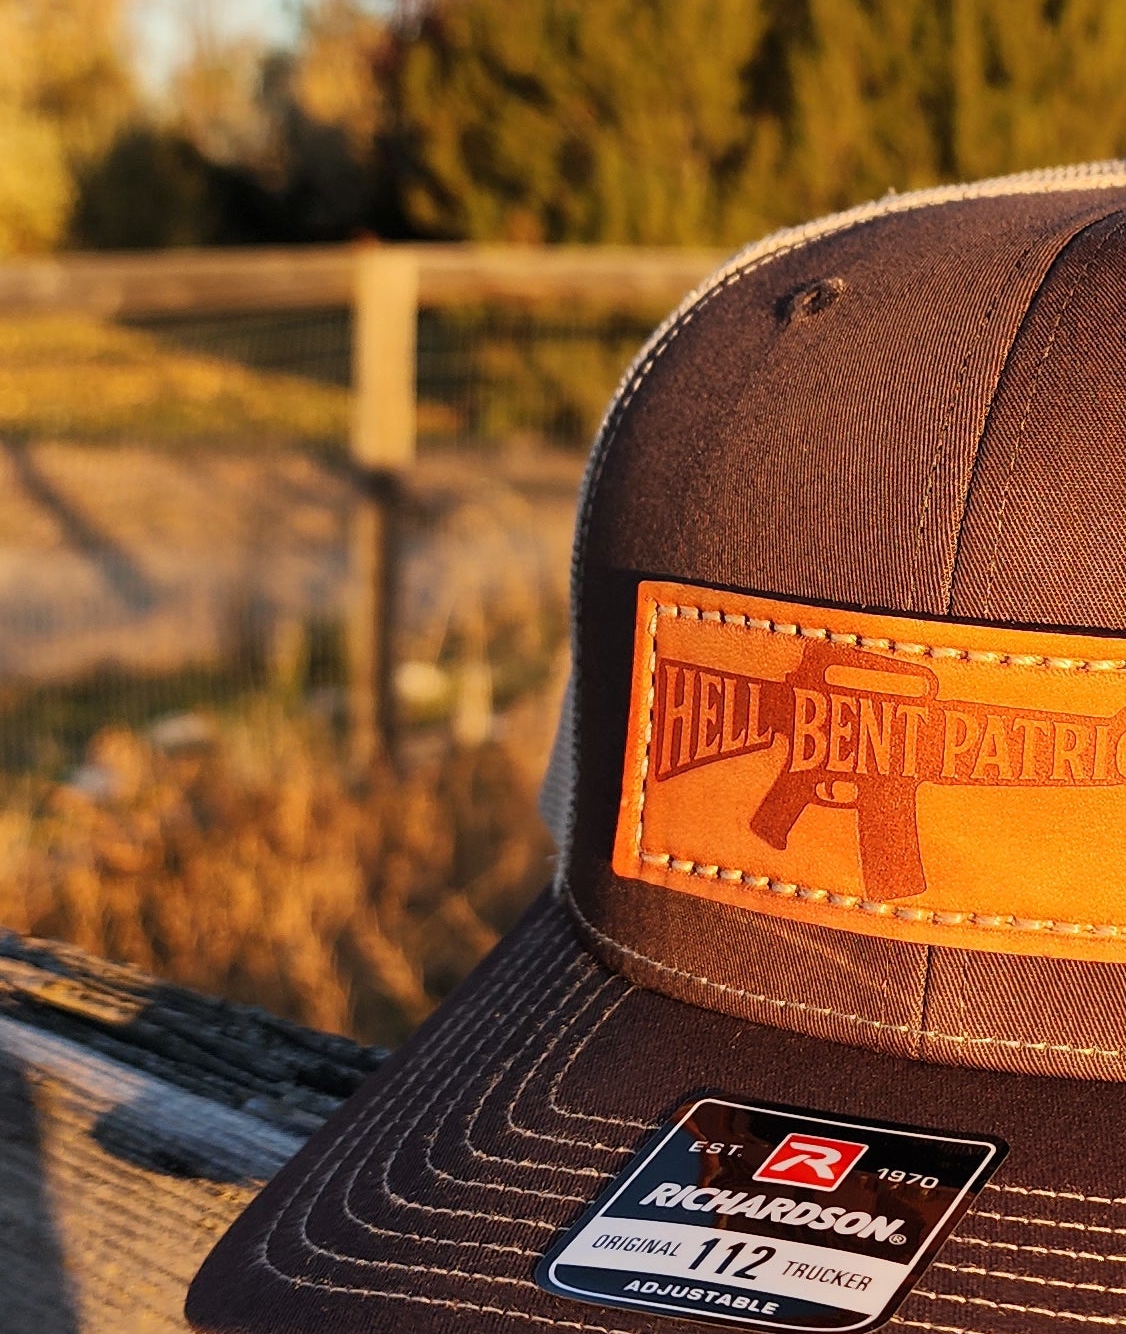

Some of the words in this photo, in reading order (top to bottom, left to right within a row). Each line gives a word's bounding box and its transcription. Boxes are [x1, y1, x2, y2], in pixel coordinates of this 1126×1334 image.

[658, 663, 776, 777] HELL
[788, 688, 931, 780] BENT
[688, 1140, 744, 1158] EST.
[876, 1167, 940, 1190] 1970
[590, 1233, 684, 1258] ORIGINAL
[688, 1236, 777, 1281] 112
[782, 1260, 873, 1293] TRUCKER
[623, 1279, 781, 1317] ADJUSTABLE
